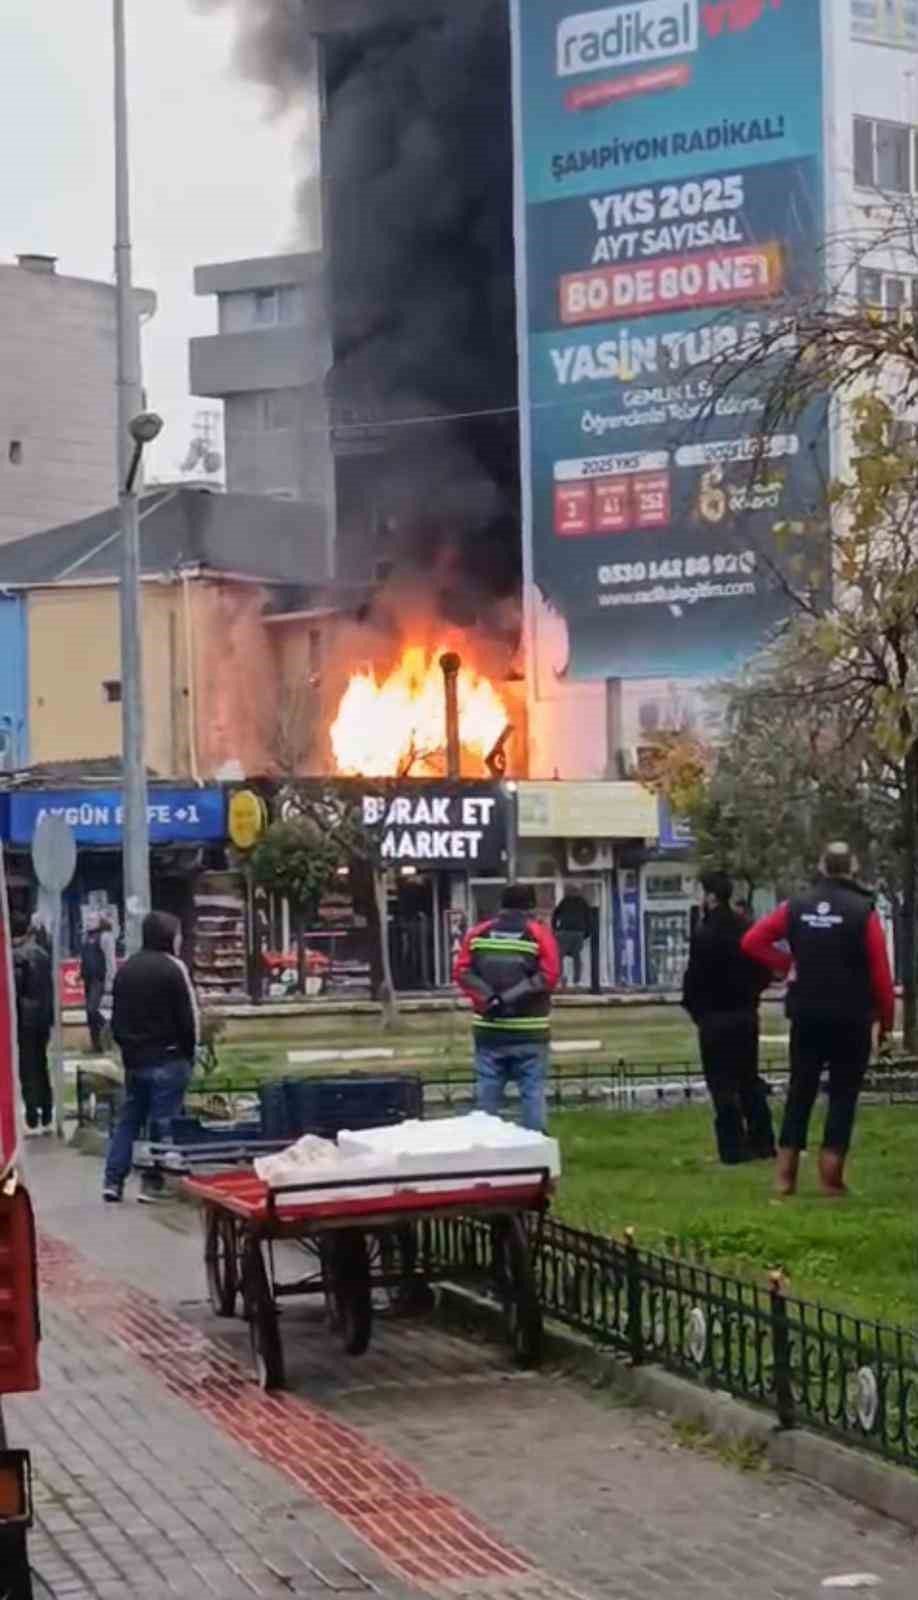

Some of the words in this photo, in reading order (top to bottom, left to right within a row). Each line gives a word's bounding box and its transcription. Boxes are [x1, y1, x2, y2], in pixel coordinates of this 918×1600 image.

[564, 2, 690, 68] radikal
[552, 135, 668, 182] ŞAMPİYON
[673, 115, 785, 152] RADİKAL!
[589, 188, 655, 231] YKS
[659, 175, 744, 220] 2025
[591, 232, 639, 264] AYT
[641, 216, 743, 255] SAYISAL
[612, 269, 654, 306] DE
[550, 329, 657, 384] YASİN
[581, 458, 615, 474] 2025
[462, 798, 495, 825] ET
